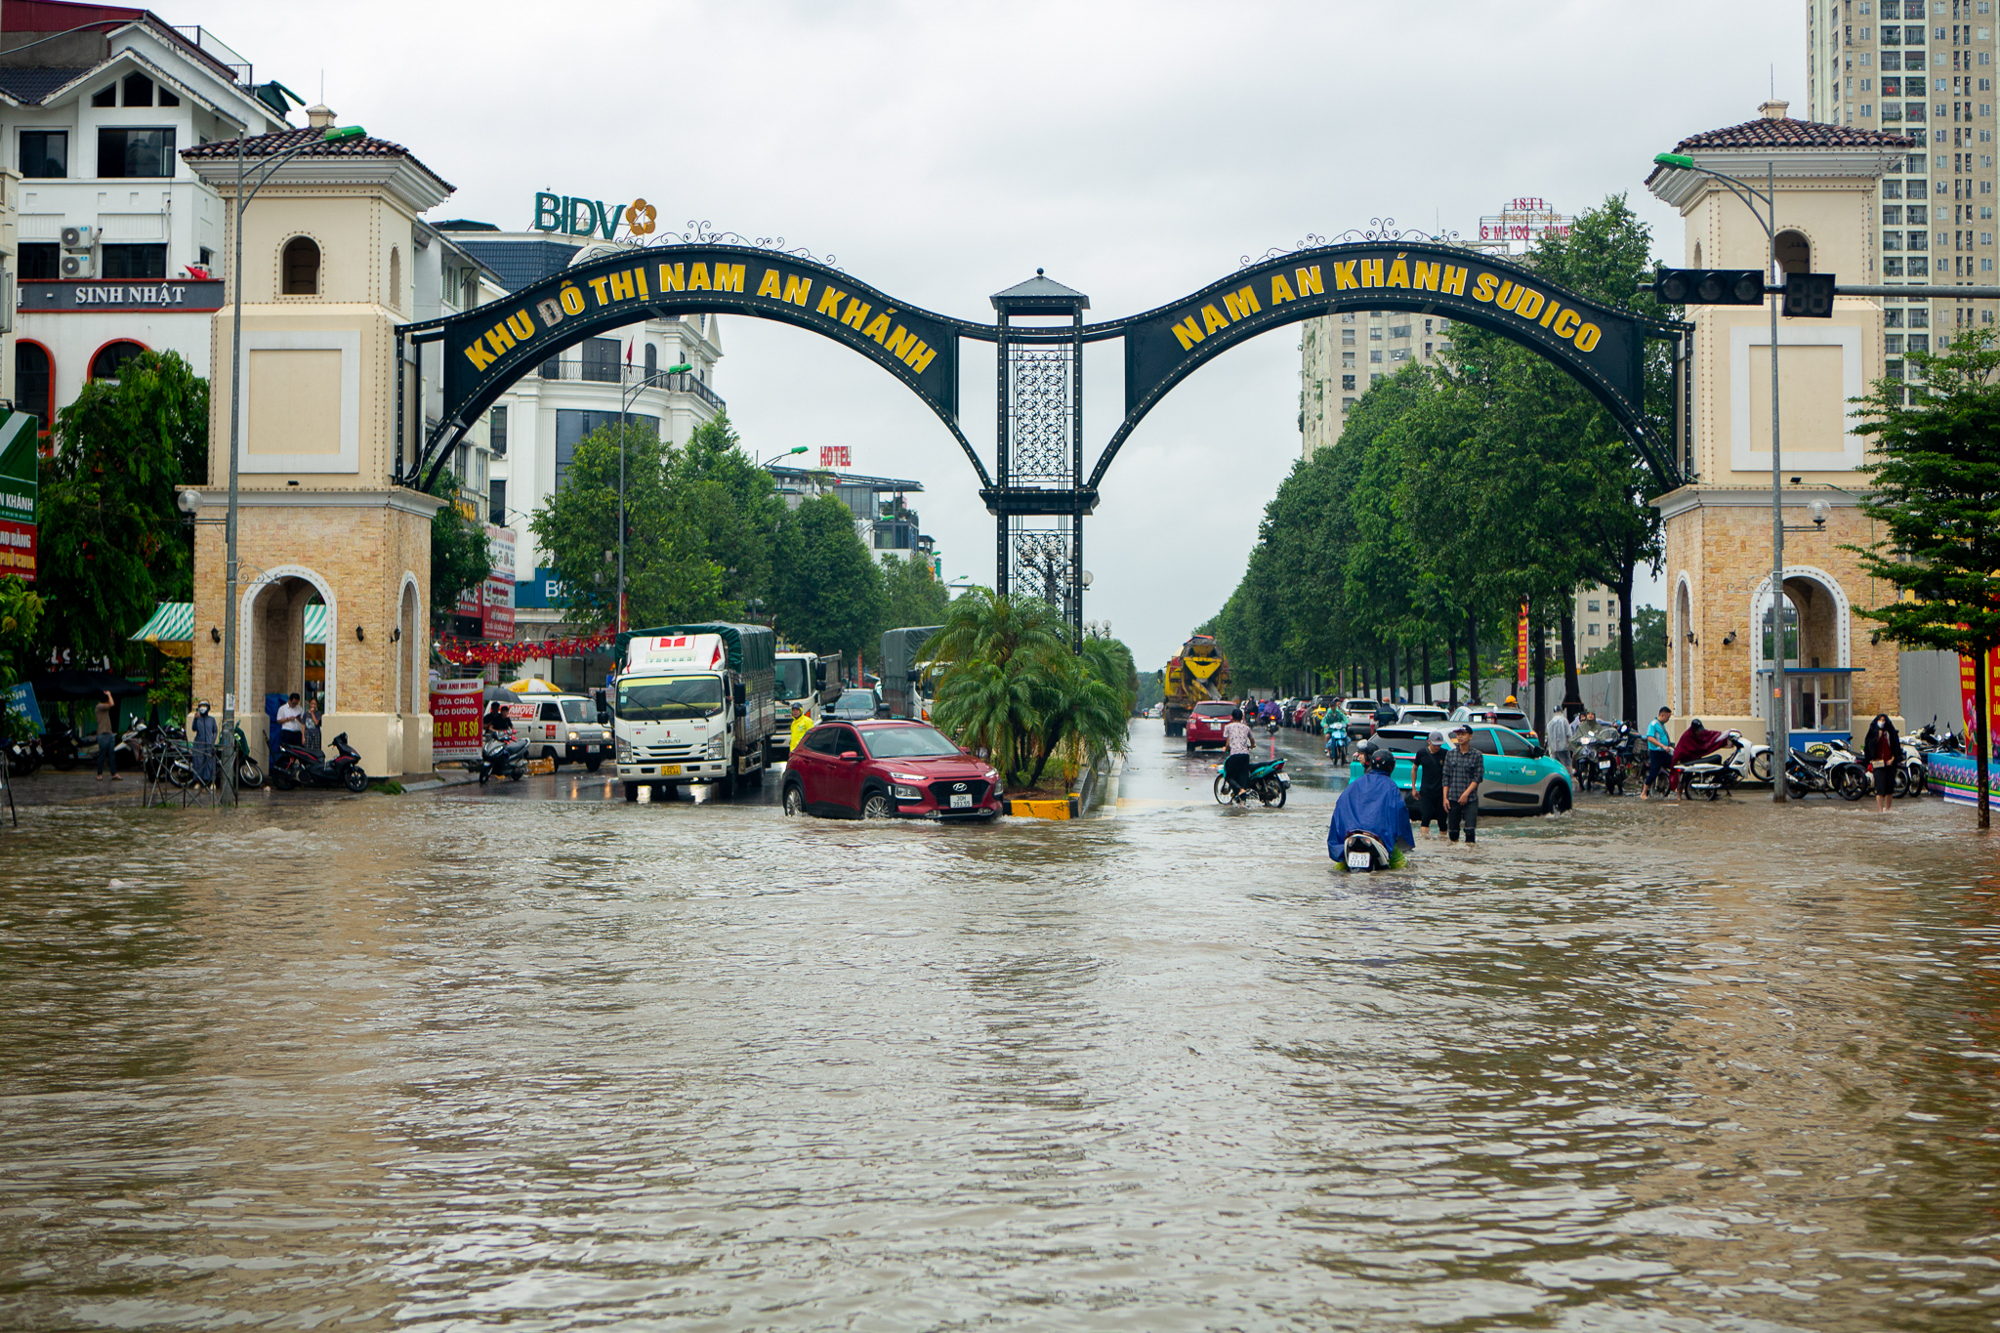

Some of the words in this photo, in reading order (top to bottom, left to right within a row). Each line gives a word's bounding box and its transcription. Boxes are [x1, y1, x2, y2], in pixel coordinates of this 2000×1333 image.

[1513, 197, 1543, 210] 18T1
[535, 192, 627, 240] BIDV
[75, 286, 124, 304] SINH
[128, 282, 186, 307] NHẬT
[1171, 284, 1262, 352] NAM
[1271, 264, 1325, 306] AN
[1333, 252, 1469, 297] KHÁNH
[1471, 272, 1602, 353] SUDICO
[464, 308, 535, 373] KHU
[536, 280, 586, 328] ĐÔ
[588, 266, 650, 307] THỊ
[659, 262, 746, 293] NAM
[756, 268, 813, 308] AN
[815, 285, 938, 375] KHÁNH
[820, 445, 852, 467] HOTEL
[6, 492, 34, 512] KHÁNH
[448, 682, 459, 690] ANH
[460, 682, 478, 690] MOTOR
[438, 696, 452, 705] SỬA
[453, 696, 475, 705] CHỮA
[509, 706, 535, 715] AMOVE
[434, 706, 450, 716] BẢO
[451, 706, 478, 715] DƯỠNG
[433, 721, 442, 738] XE
[443, 721, 453, 738] GA
[458, 721, 468, 737] XE
[468, 715, 480, 737] SỐ
[1808, 744, 1830, 753] SECURITY
